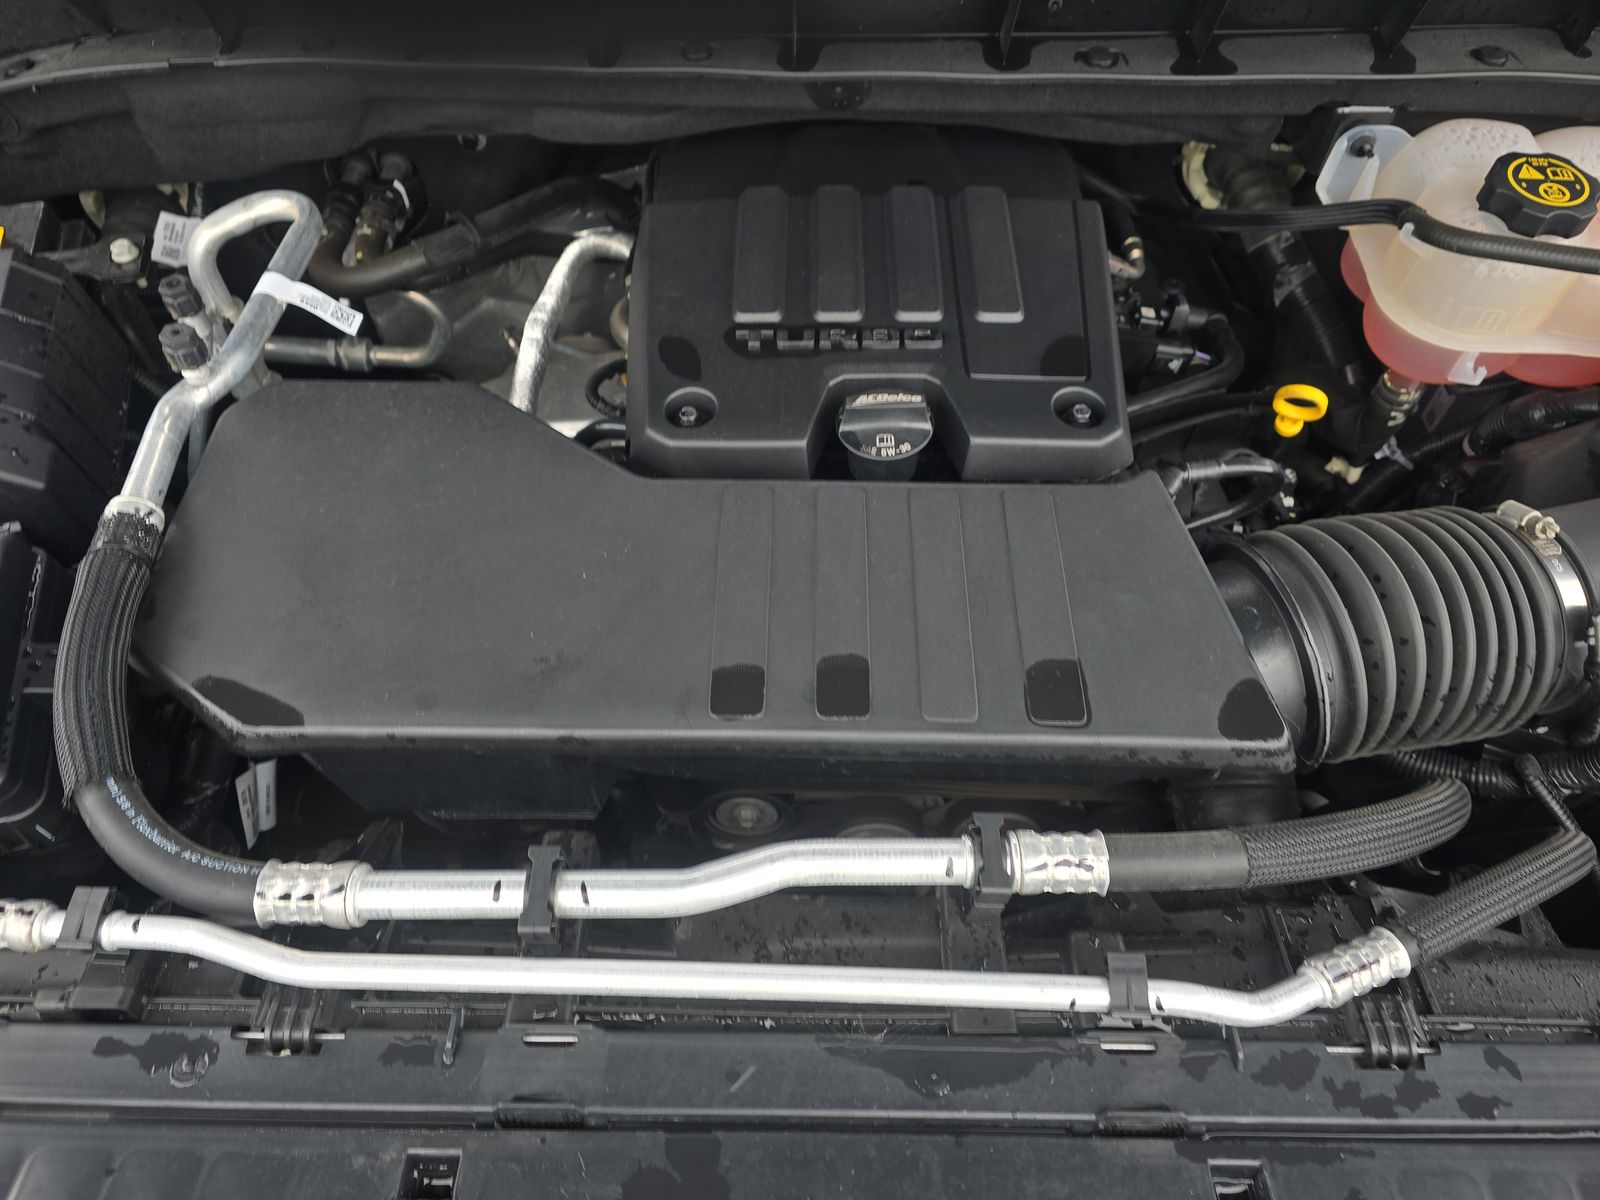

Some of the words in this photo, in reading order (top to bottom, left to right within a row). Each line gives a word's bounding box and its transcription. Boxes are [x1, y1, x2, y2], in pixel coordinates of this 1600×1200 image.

[735, 329, 943, 351] TURBO
[853, 392, 922, 406] ACDelco
[201, 856, 249, 875] SUCTION
